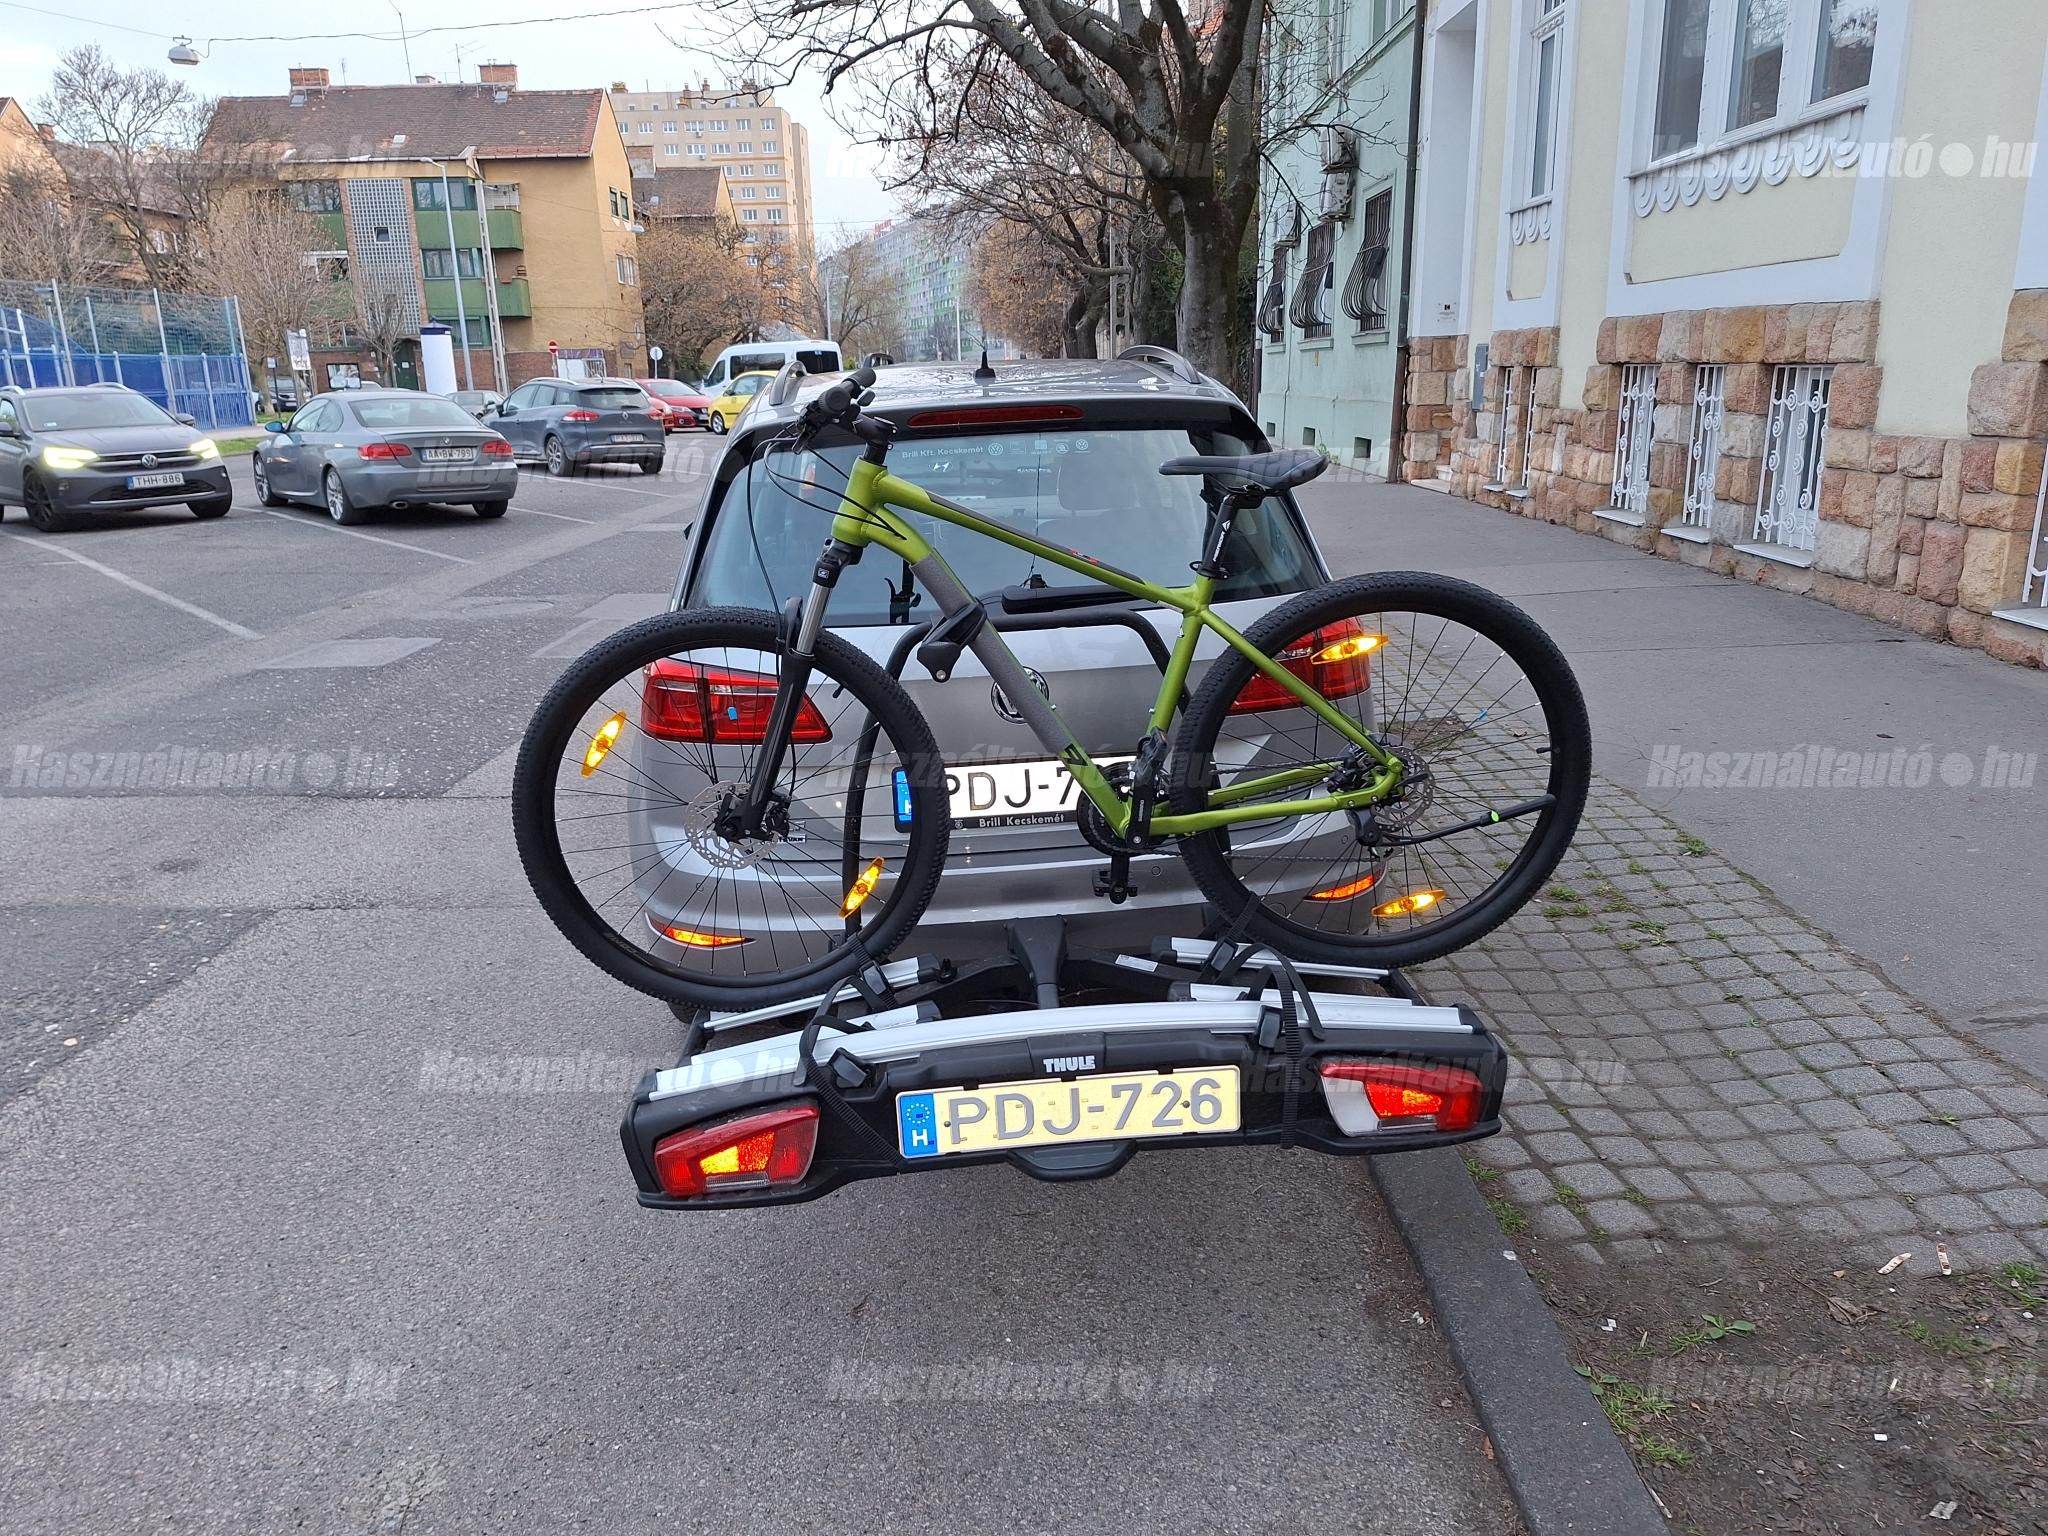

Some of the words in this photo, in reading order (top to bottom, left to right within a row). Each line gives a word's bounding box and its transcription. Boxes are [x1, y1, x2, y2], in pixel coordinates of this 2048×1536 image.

[136, 472, 182, 487] THH-886
[979, 816, 1001, 828] Brill
[1006, 813, 1065, 826] Kecskemét
[1043, 1055, 1096, 1073] THULE
[947, 1077, 1223, 1145] PDJ-726
[911, 1129, 928, 1147] H
